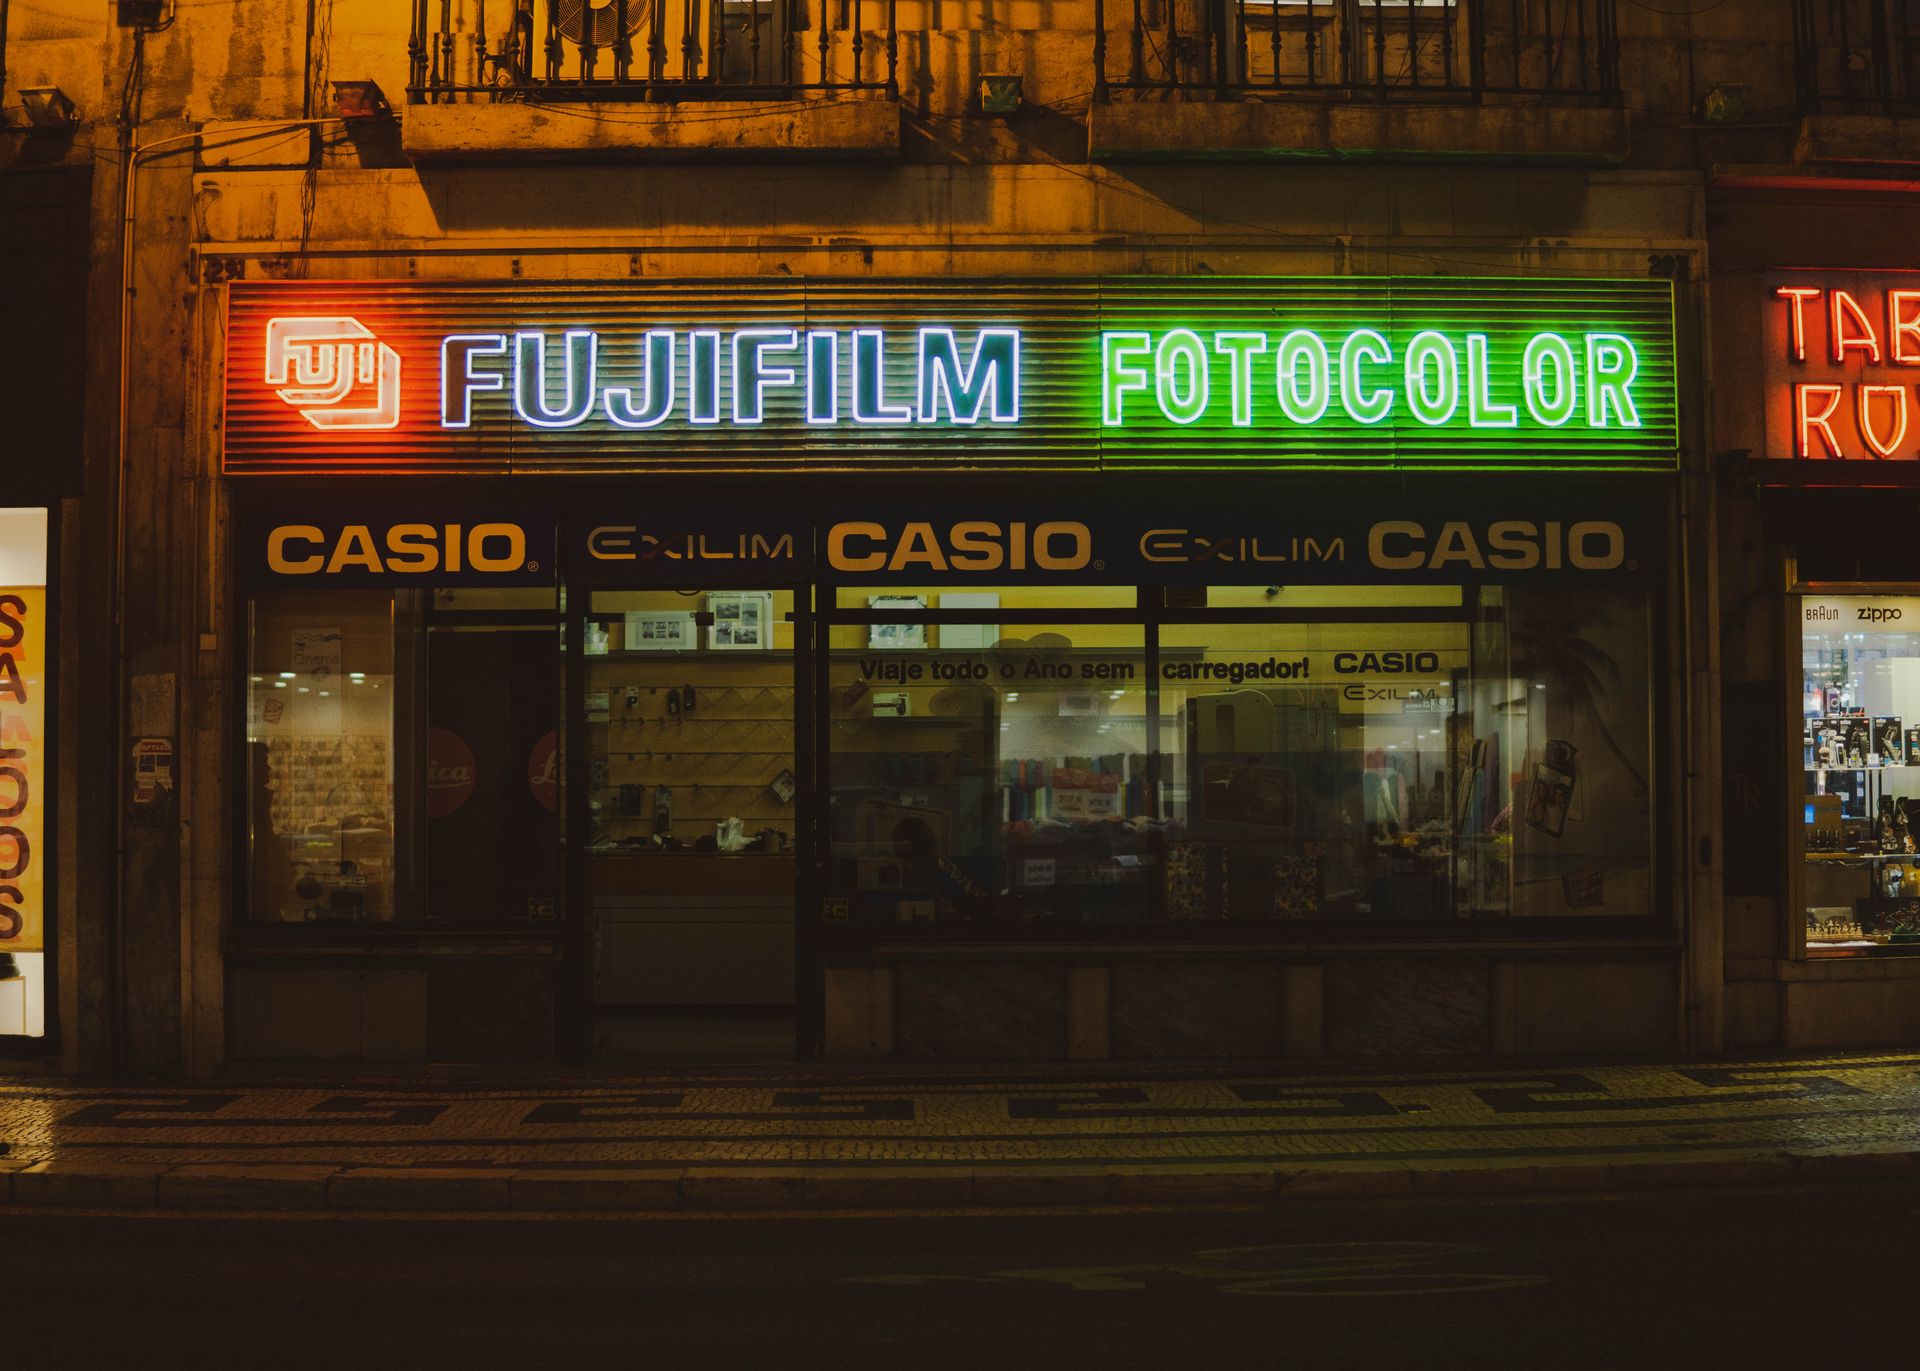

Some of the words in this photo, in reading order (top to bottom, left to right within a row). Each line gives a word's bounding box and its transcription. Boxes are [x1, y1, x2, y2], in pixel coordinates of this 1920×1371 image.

[440, 326, 1020, 428] FUJIFILM
[1102, 328, 1642, 427] FOTOCOLOR
[1806, 605, 1839, 621] BRAUN
[859, 658, 923, 685] Viaje
[930, 658, 989, 681] todo
[1000, 662, 1016, 680] o
[1023, 657, 1073, 680] Ano
[1080, 661, 1136, 680] sem
[1161, 656, 1311, 685] carregador!
